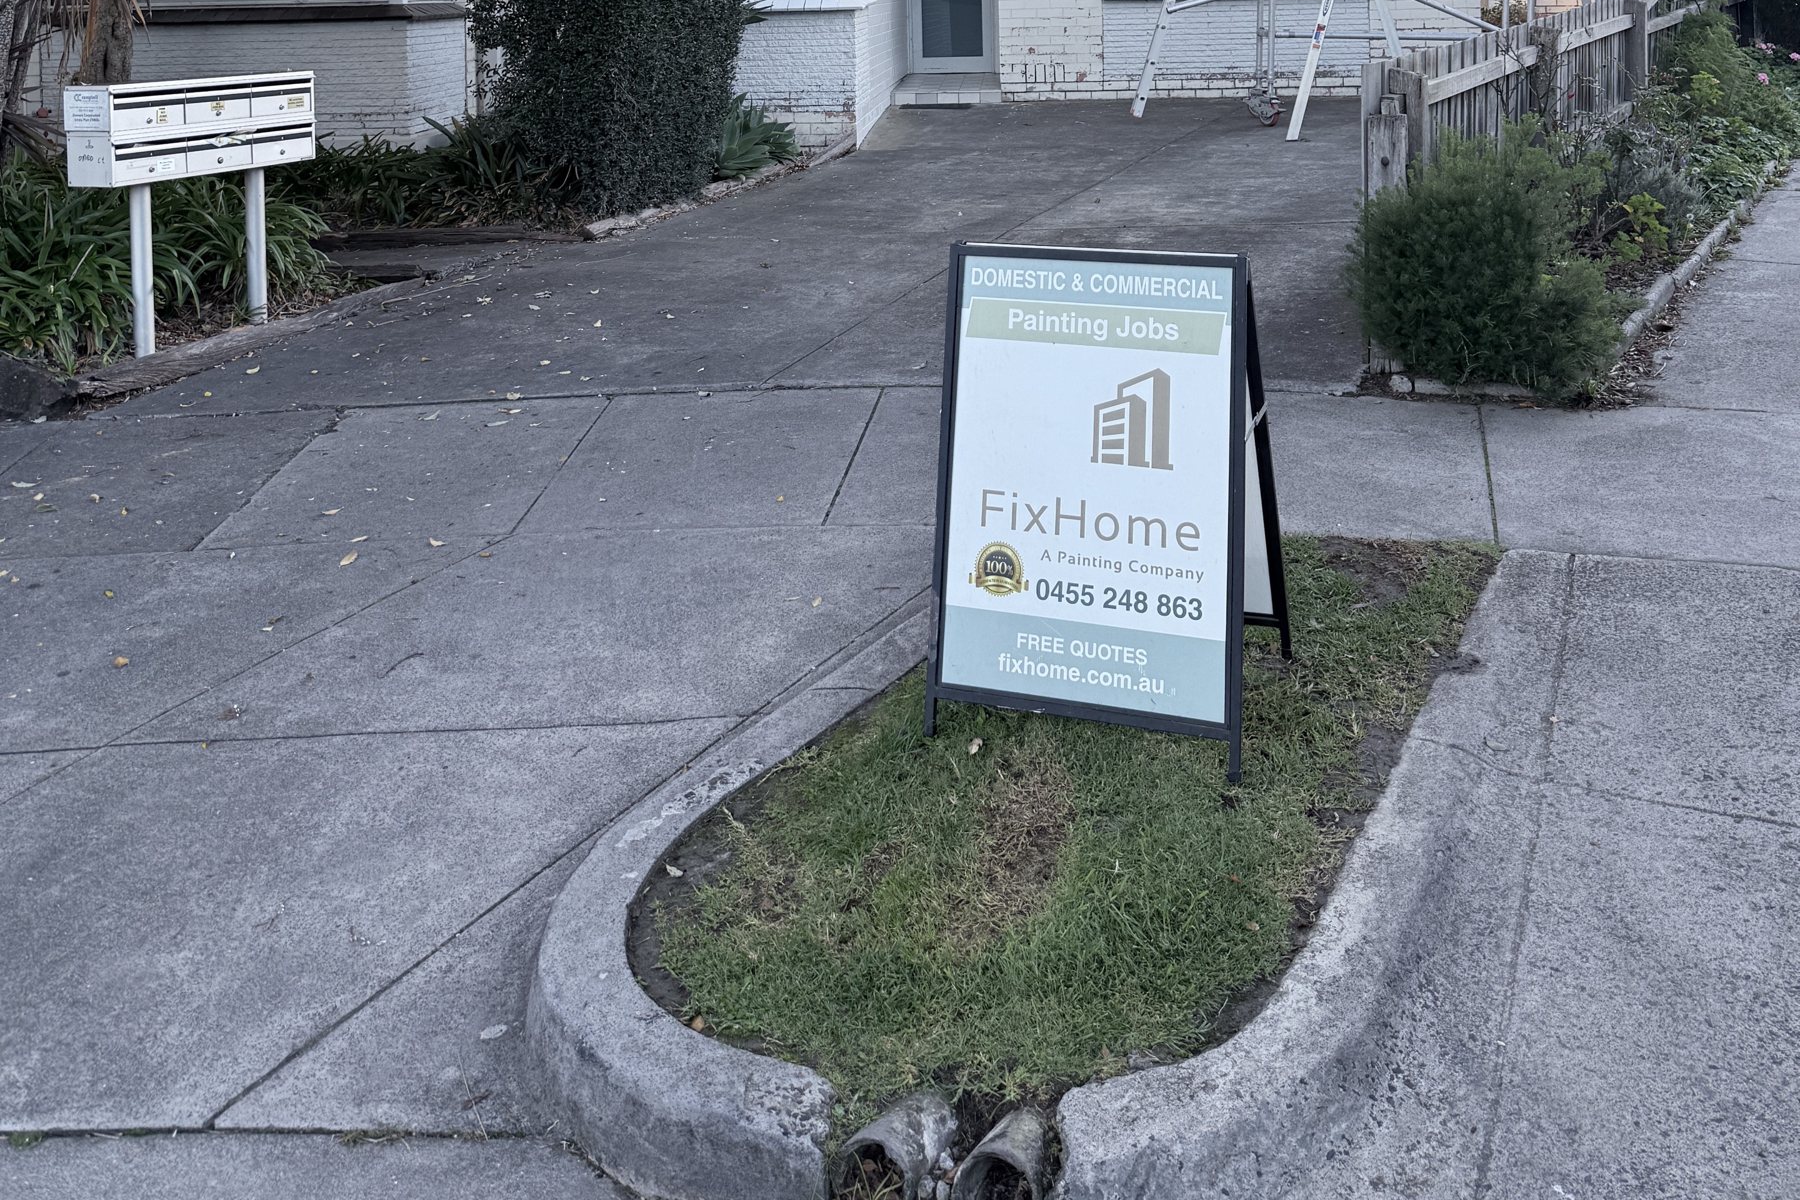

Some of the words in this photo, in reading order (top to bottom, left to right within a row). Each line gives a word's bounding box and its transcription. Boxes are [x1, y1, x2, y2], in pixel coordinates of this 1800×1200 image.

[970, 267, 1066, 291] DOMESTIC
[1071, 273, 1084, 292] &
[1090, 274, 1223, 300] COMMERCIAL
[1008, 308, 1108, 341] Painting
[1116, 316, 1179, 341] Jobs
[980, 488, 1201, 552] FixHome
[985, 560, 1013, 576] 100%
[1040, 549, 1052, 562] A
[1057, 551, 1123, 573] Painting
[1128, 560, 1205, 583] Company
[1036, 578, 1095, 607] 0455
[1103, 587, 1148, 613] 248
[1157, 594, 1203, 621] 863
[1017, 632, 1064, 655] FREE
[1070, 640, 1148, 665] QUOTES
[998, 653, 1165, 695] fixhome.com.au
